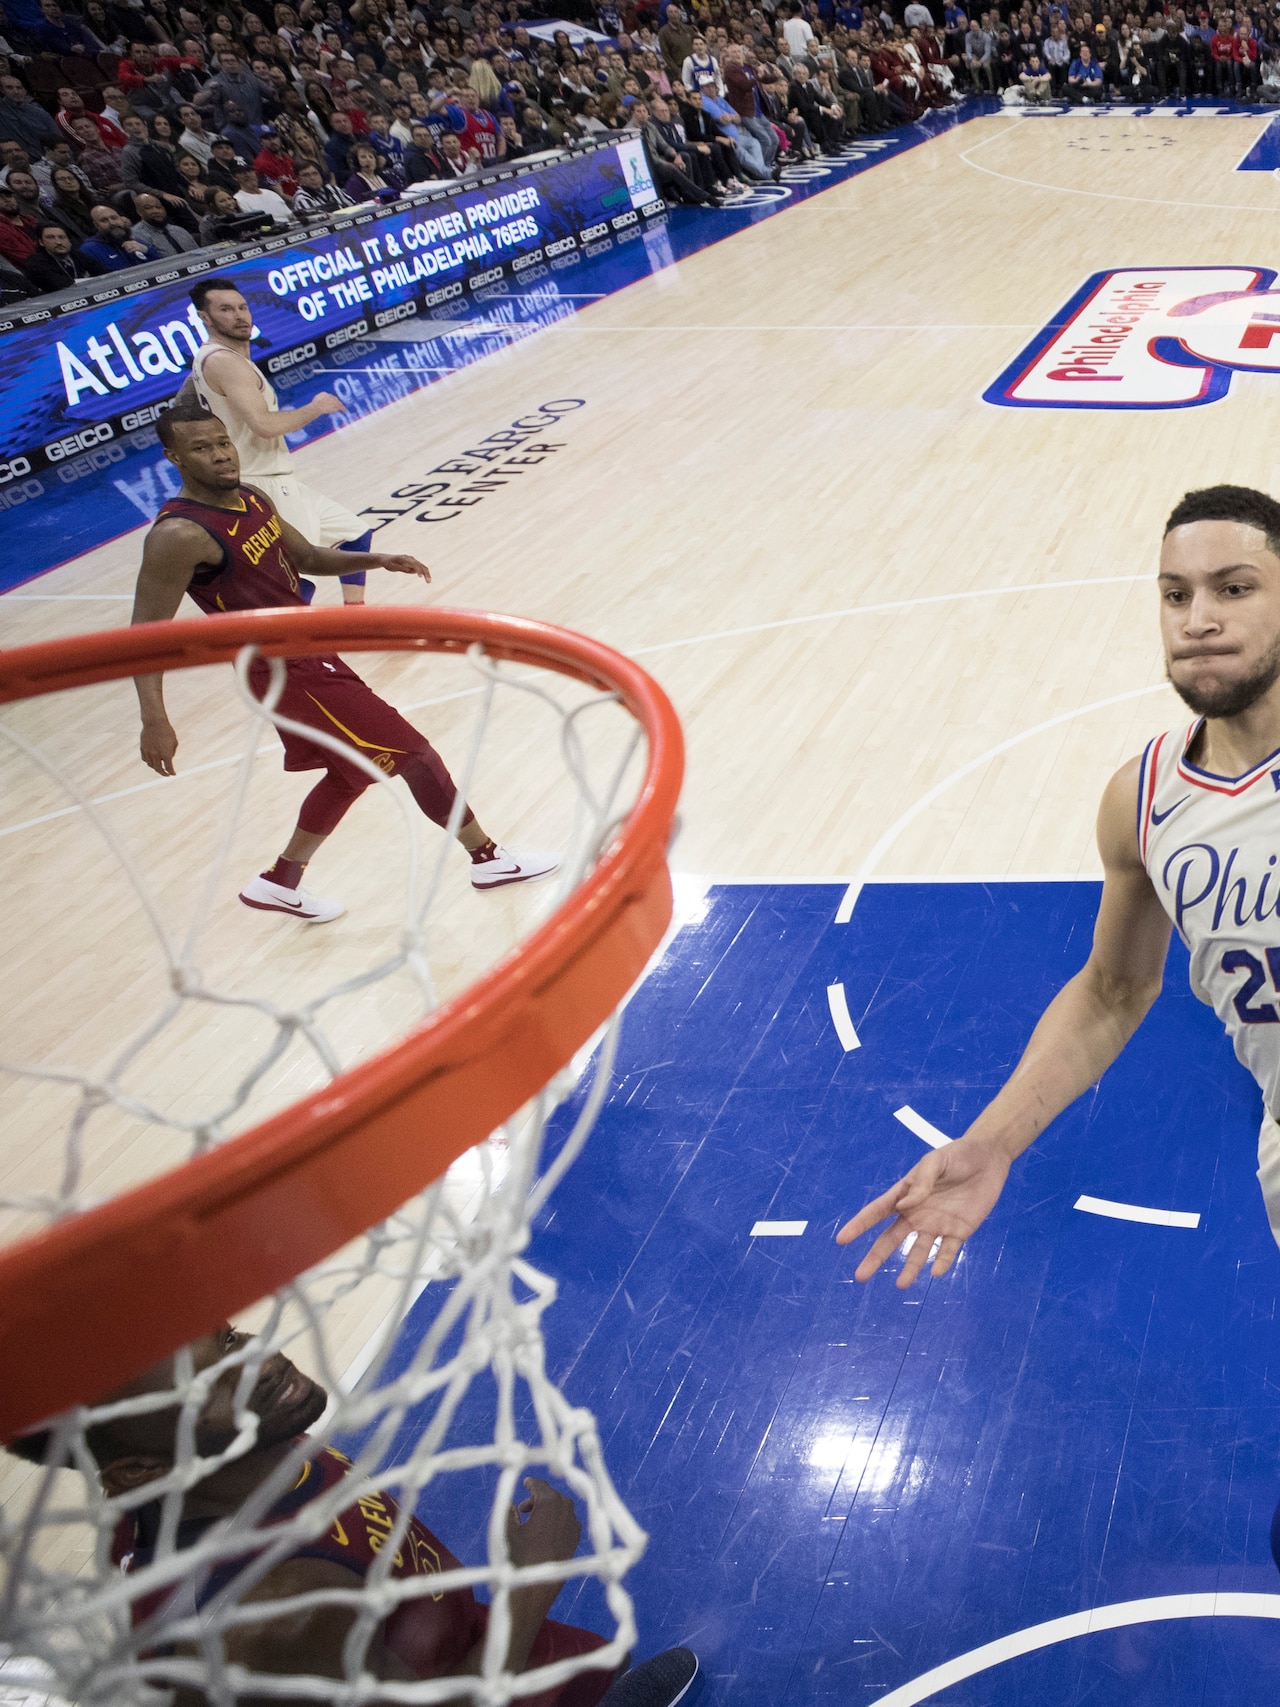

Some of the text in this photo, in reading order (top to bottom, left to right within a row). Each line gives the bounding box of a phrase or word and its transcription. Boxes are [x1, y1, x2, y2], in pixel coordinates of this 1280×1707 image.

[481, 143, 496, 158] 10
[628, 180, 653, 196] GEICO
[22, 310, 51, 324] GEICO
[60, 298, 89, 313] GEICO
[93, 288, 120, 302] GEICO
[124, 279, 149, 293] GEICO
[155, 270, 180, 284] GEICO
[187, 261, 210, 274] GEICO
[215, 253, 238, 265] GEICO
[241, 247, 263, 259] GEICO
[265, 239, 286, 250] GEICO
[287, 232, 307, 243] GEICO
[309, 226, 329, 238] GEICO
[334, 220, 353, 230] GEICO
[355, 215, 373, 224] GEICO
[376, 208, 393, 218] GEICO
[395, 202, 412, 212] GEICO
[413, 196, 430, 206] GEICO
[431, 190, 447, 200] GEICO
[446, 186, 463, 196] GEICO
[463, 181, 479, 191] GEICO
[267, 186, 541, 297] OFFICIAL IT & COPIER PROVIDER
[297, 216, 539, 322] OF THE PHILADELPHIA 76ERS
[45, 422, 114, 462] GEICO
[121, 398, 176, 432] GEIC
[268, 342, 317, 374] GEICO
[325, 320, 369, 349] GEICO
[374, 300, 418, 328] GEICO
[425, 281, 463, 308] GEICO
[469, 266, 504, 290] GEICO
[511, 249, 544, 272] GEICO
[544, 236, 577, 258] GEICO
[579, 222, 609, 243] GEICO
[611, 210, 638, 230] GEICO
[641, 199, 666, 217] GEICO
[56, 303, 261, 406] Atlant
[1046, 282, 1166, 382] Philadelphia
[425, 398, 586, 476] FARGO
[415, 443, 567, 522] CENTER
[241, 514, 282, 565] CLEVELA
[279, 547, 298, 592] 1
